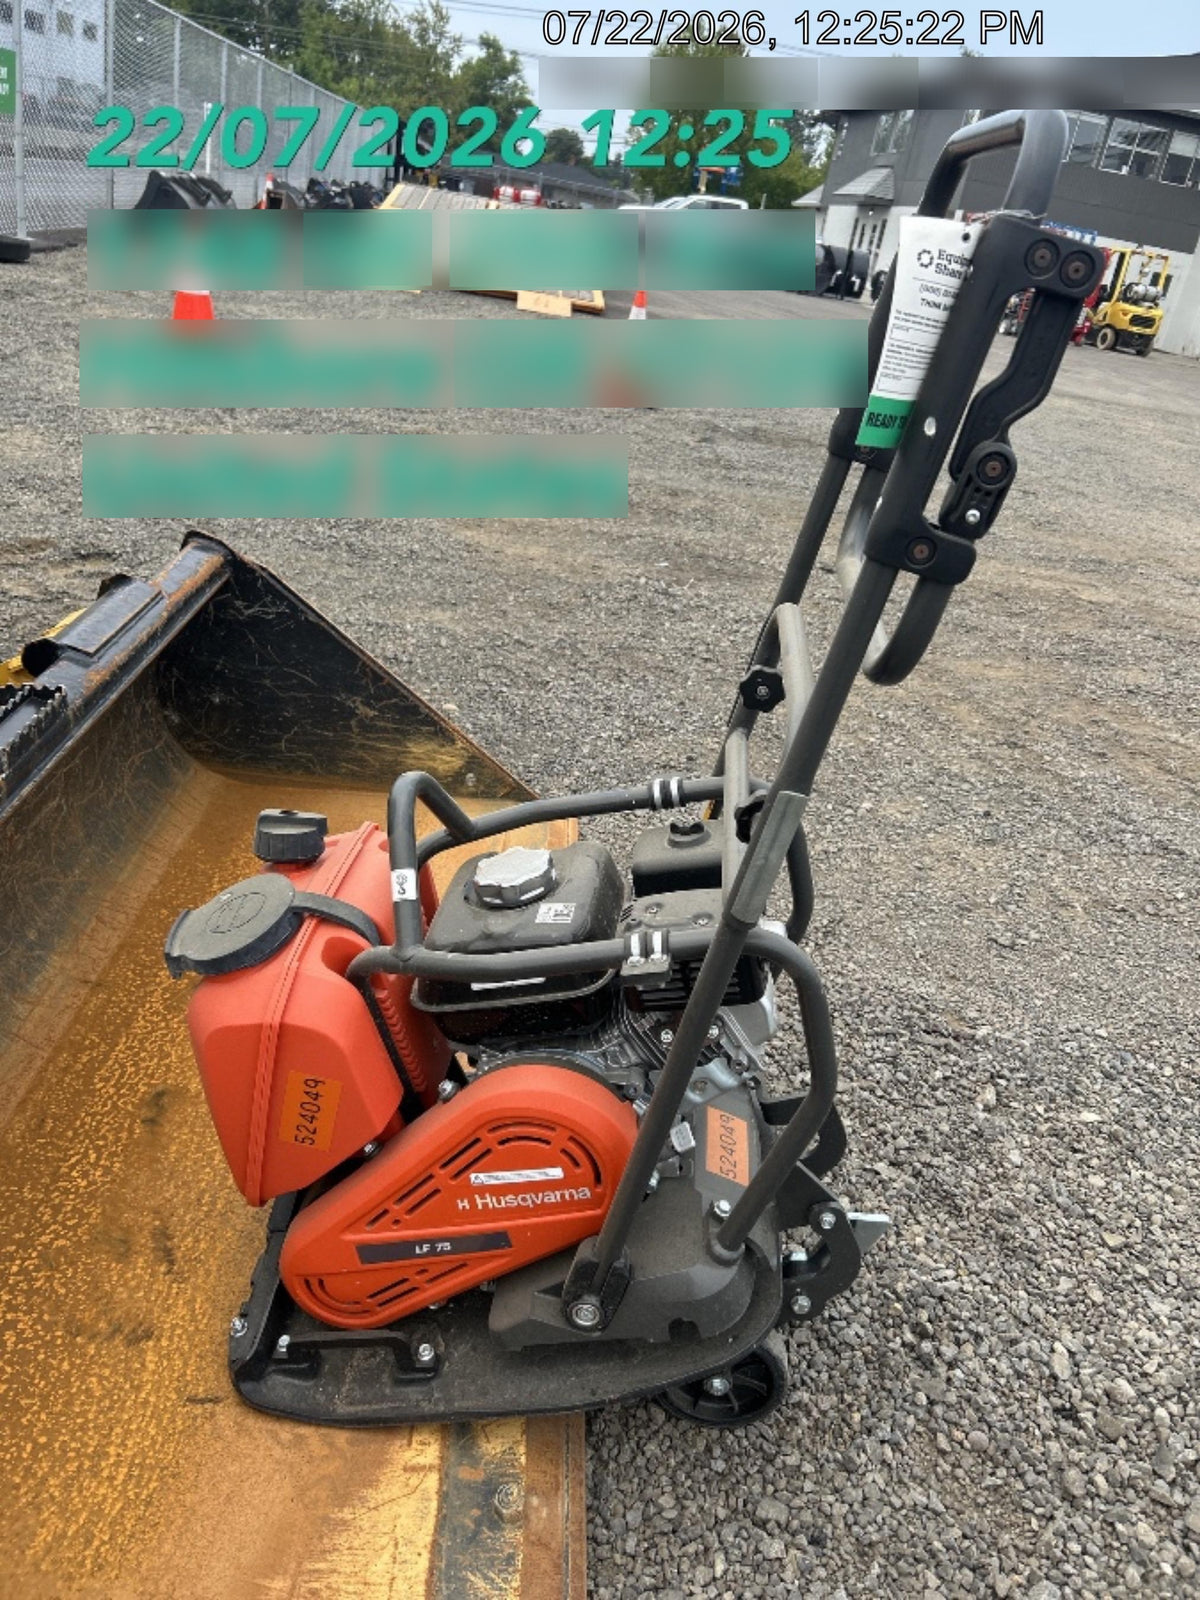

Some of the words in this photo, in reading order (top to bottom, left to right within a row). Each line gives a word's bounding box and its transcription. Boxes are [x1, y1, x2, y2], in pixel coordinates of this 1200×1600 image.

[937, 248, 969, 268] Equip
[866, 412, 900, 429] READY
[294, 1078, 326, 1146] 524049
[720, 1113, 738, 1180] 524049
[474, 1187, 592, 1210] Husqvarna
[415, 1243, 431, 1254] LF
[435, 1242, 452, 1252] 75
